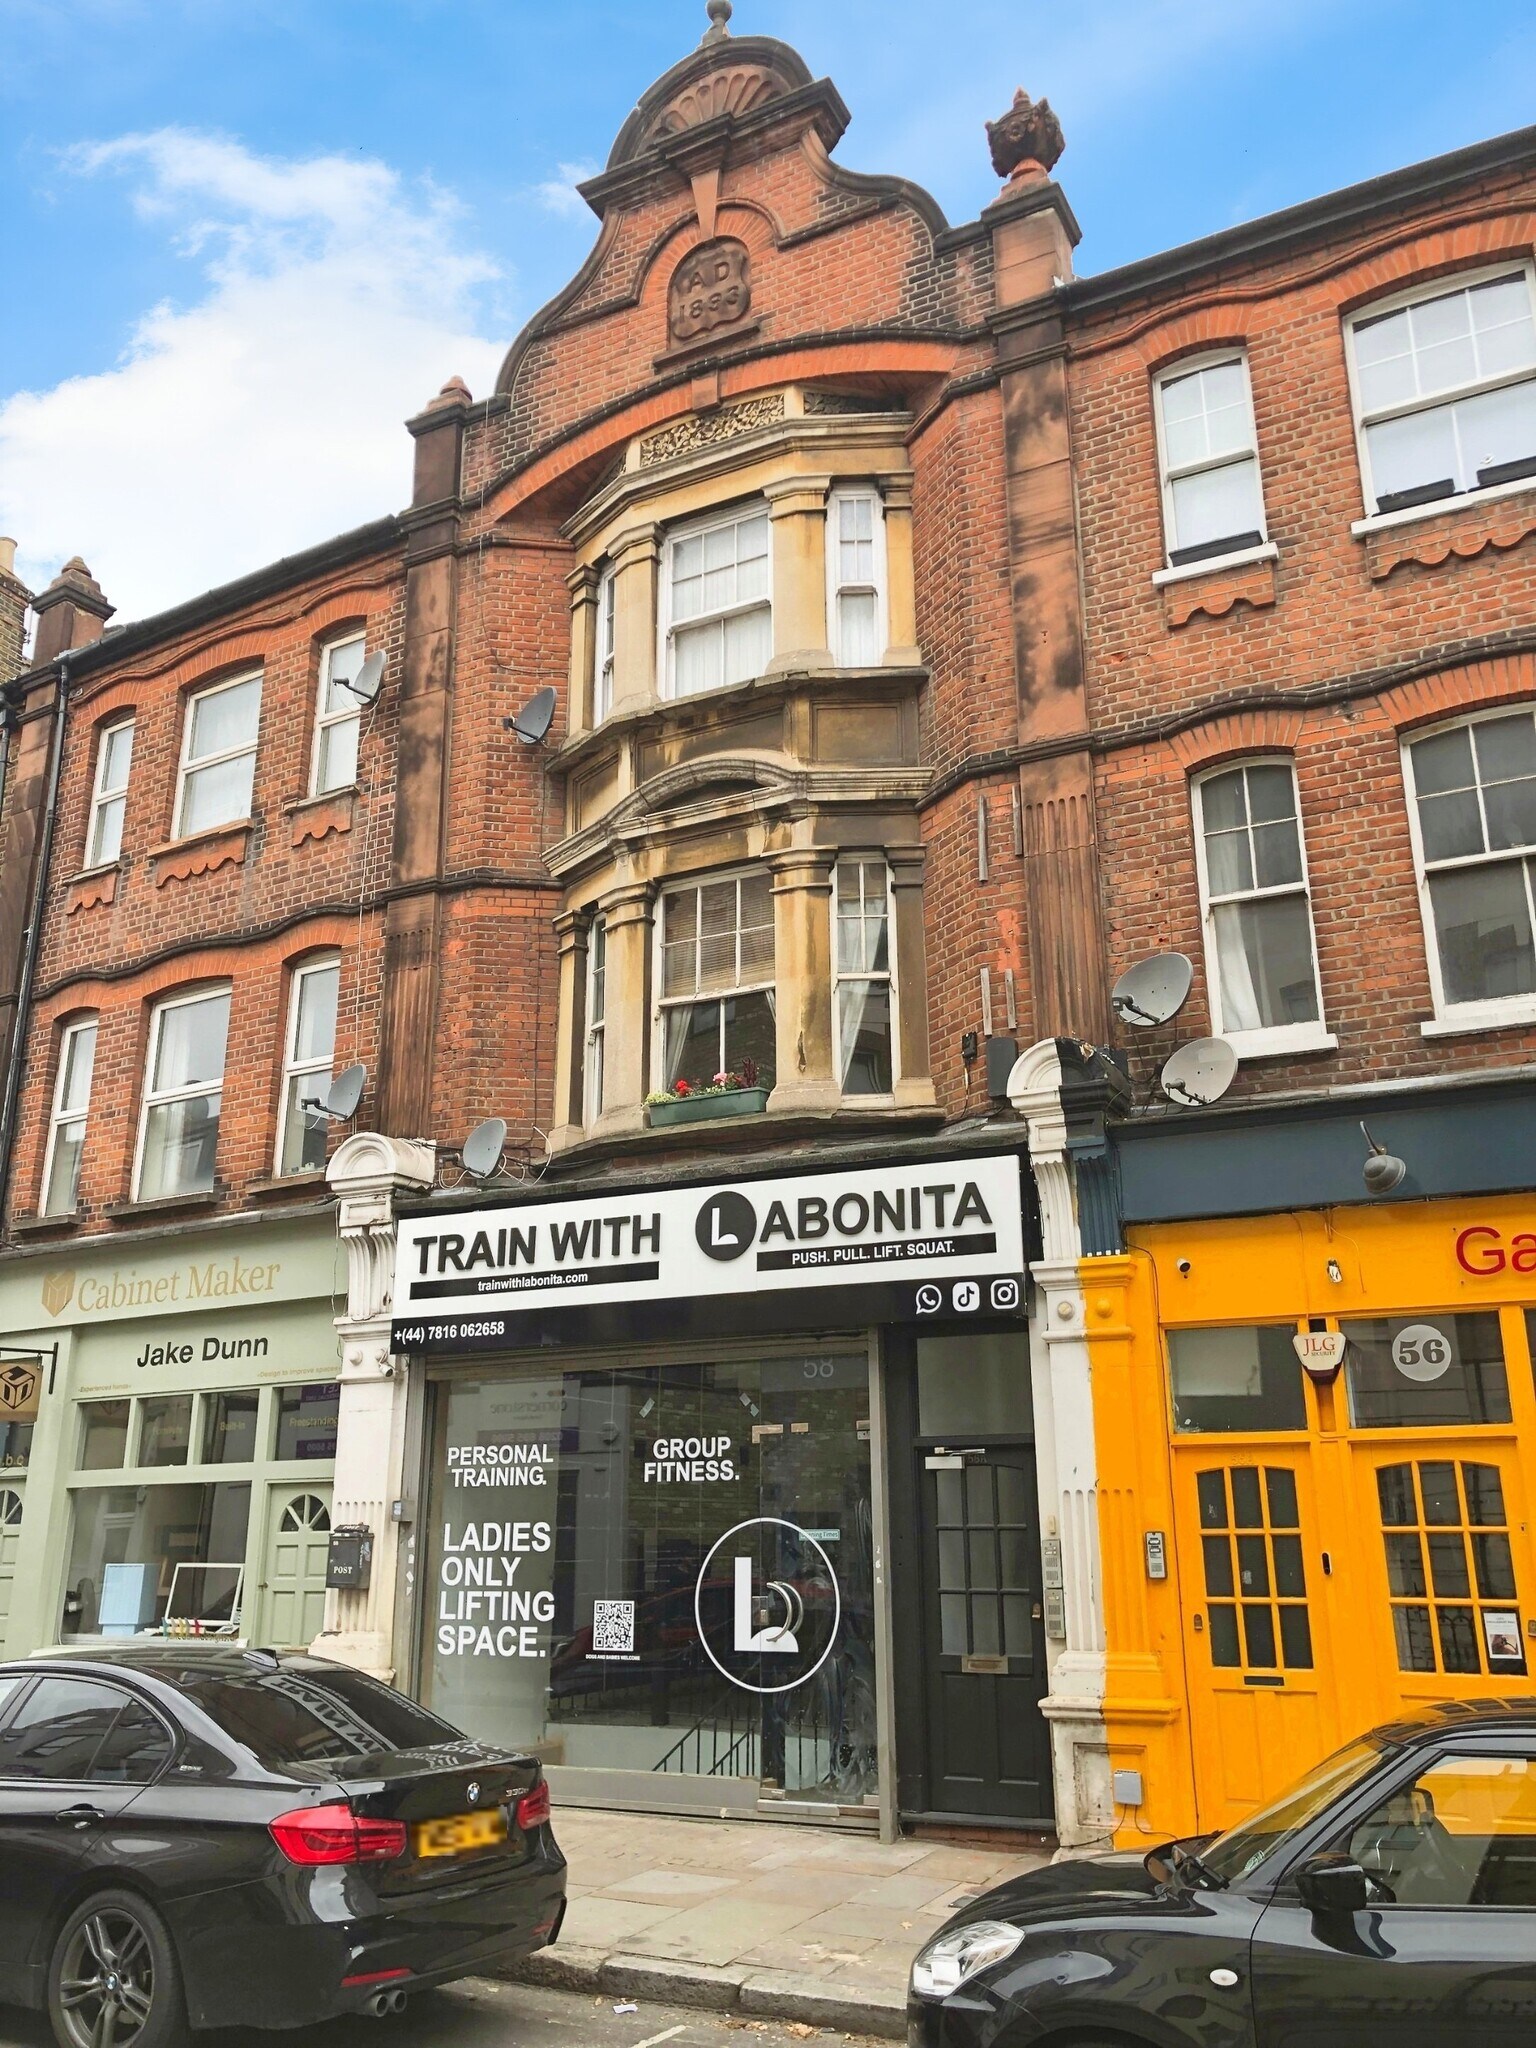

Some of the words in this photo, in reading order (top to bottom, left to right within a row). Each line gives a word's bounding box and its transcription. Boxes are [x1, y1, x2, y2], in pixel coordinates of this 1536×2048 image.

[412, 1225, 537, 1274] TRAIN
[549, 1212, 661, 1262] WITH
[792, 1251, 830, 1265] PUSH.
[833, 1246, 870, 1261] PULL.
[874, 1244, 904, 1258] LIFT.
[907, 1240, 955, 1256] SQUAT.
[78, 1269, 180, 1312] Cabinet
[185, 1255, 281, 1299] Maker
[477, 1273, 588, 1291] trainwithlabonita.com
[394, 1327, 425, 1345] +(44)
[428, 1324, 458, 1340] 7816
[460, 1321, 505, 1337] 062658
[136, 1341, 194, 1368] Jake
[201, 1337, 269, 1361] Dunn
[1303, 1336, 1336, 1356] JLG
[1398, 1338, 1446, 1366] 56
[803, 1356, 834, 1379] 58
[447, 1444, 554, 1466] PERSONAL
[653, 1436, 732, 1460] GROUP
[451, 1466, 547, 1487] TRAINING.
[644, 1460, 740, 1483] FITNESS.
[444, 1522, 551, 1552] LADIES
[333, 1566, 353, 1575] POST
[441, 1556, 522, 1587] ONLY
[439, 1590, 555, 1622] LIFTING
[437, 1624, 546, 1658] SPACE.
